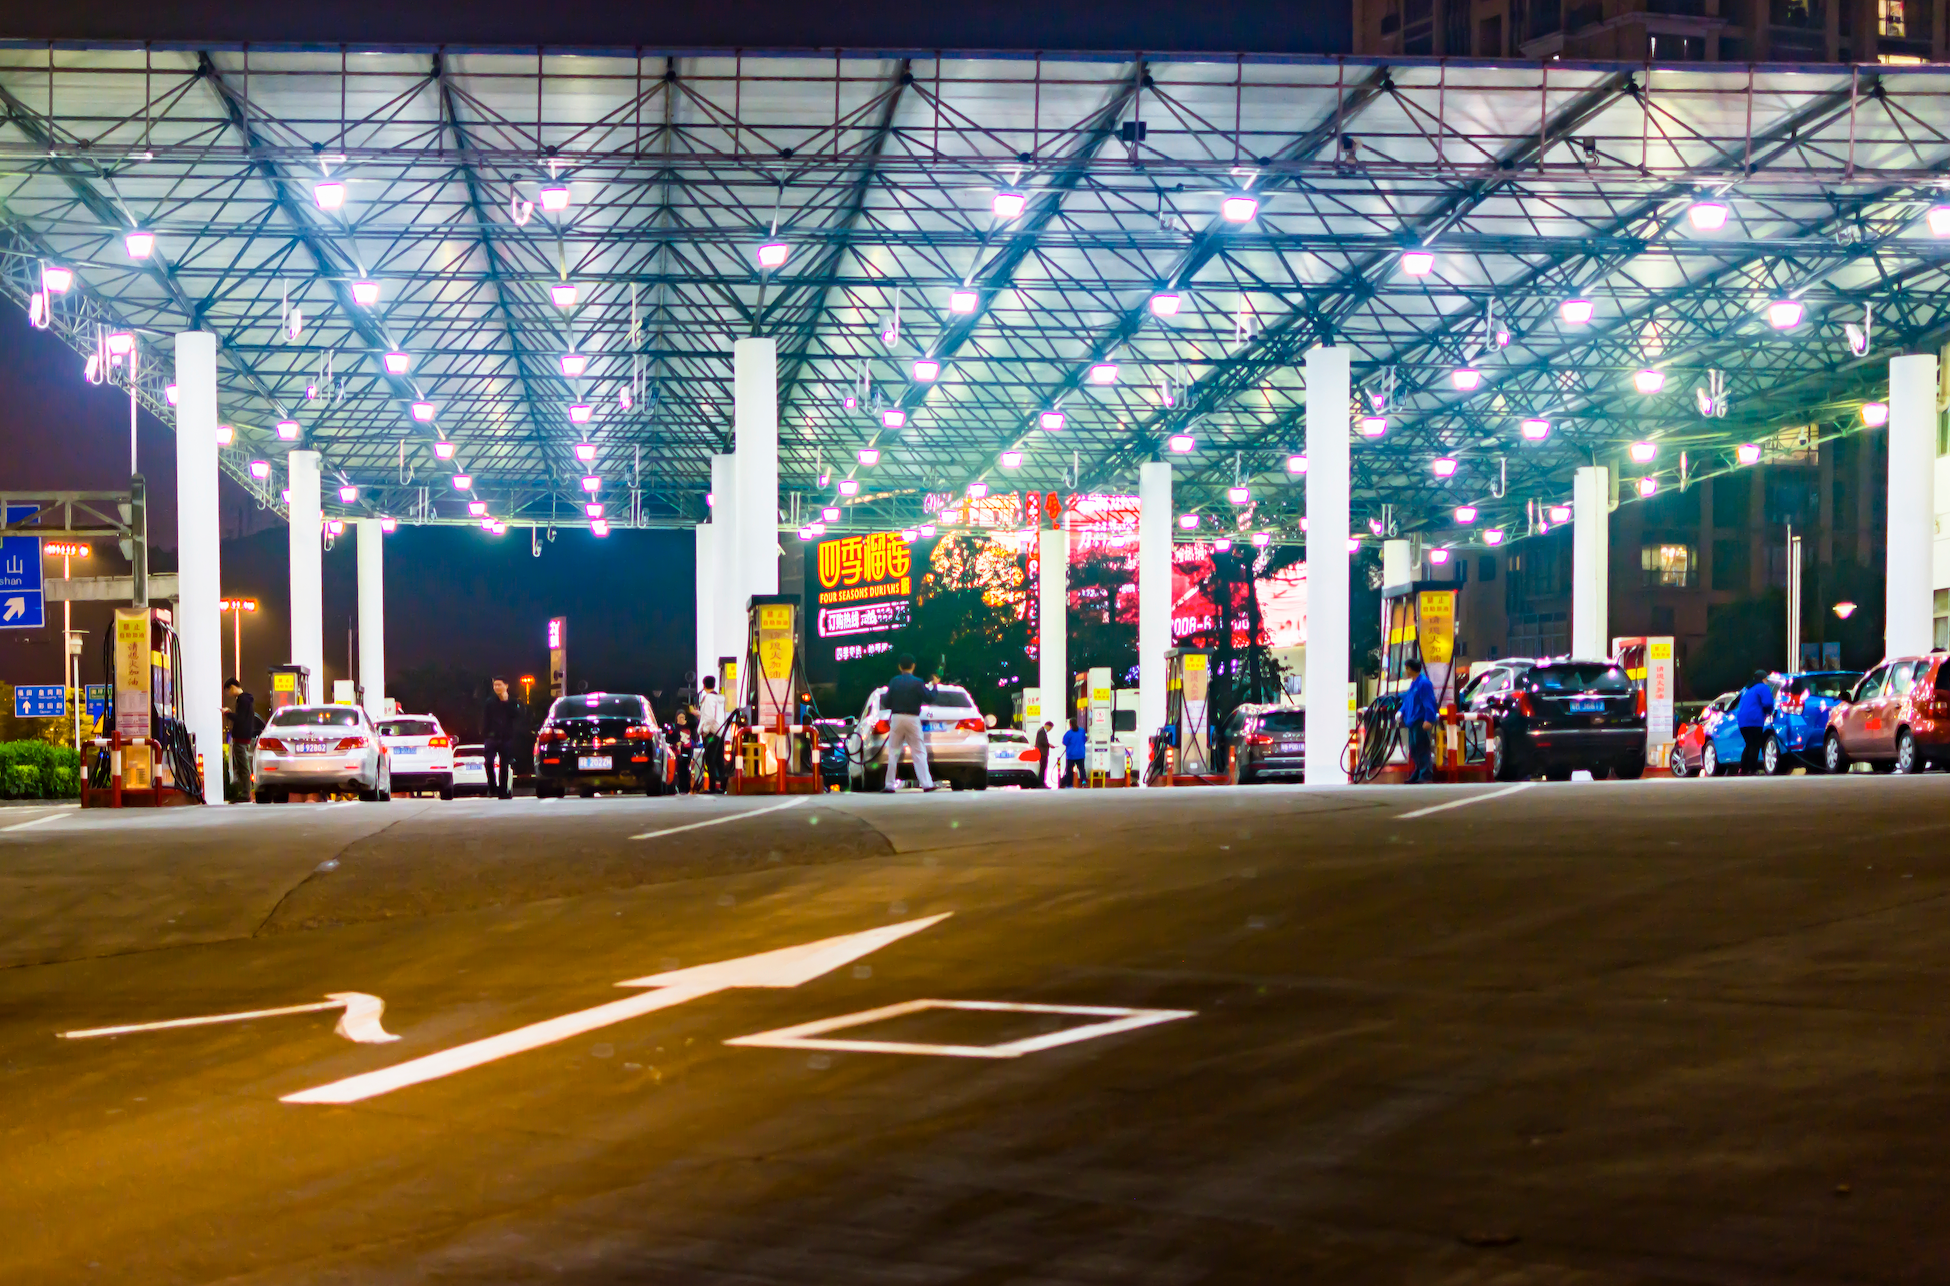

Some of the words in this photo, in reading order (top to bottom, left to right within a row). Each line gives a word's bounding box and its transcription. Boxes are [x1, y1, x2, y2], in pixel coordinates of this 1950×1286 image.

[6, 555, 23, 574] 山
[819, 591, 838, 604] FOUR
[838, 586, 868, 602] SEASONS
[869, 582, 900, 597] DURIANS
